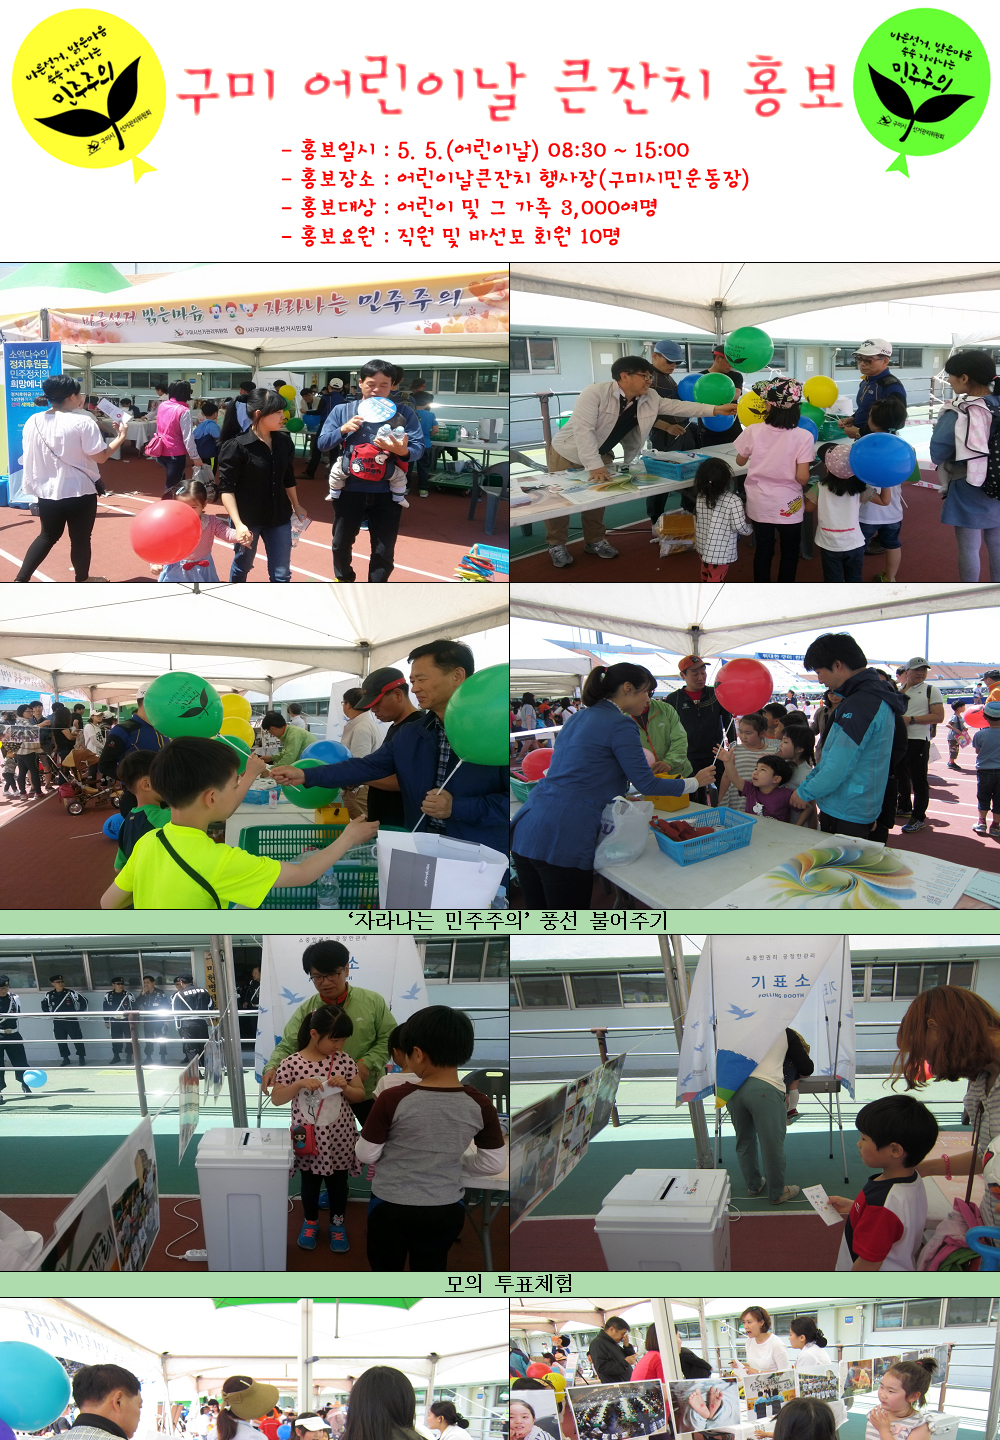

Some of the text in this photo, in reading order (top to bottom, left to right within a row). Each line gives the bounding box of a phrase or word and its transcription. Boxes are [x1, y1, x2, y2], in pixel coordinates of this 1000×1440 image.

[82, 287, 464, 329] 바른선거 밝은마음 자라나는 민주주의
[9, 349, 49, 360] 소액다수의
[10, 359, 51, 370] 정치후원금,
[10, 369, 50, 380] 민주정치의
[10, 379, 43, 389] 희망에너
